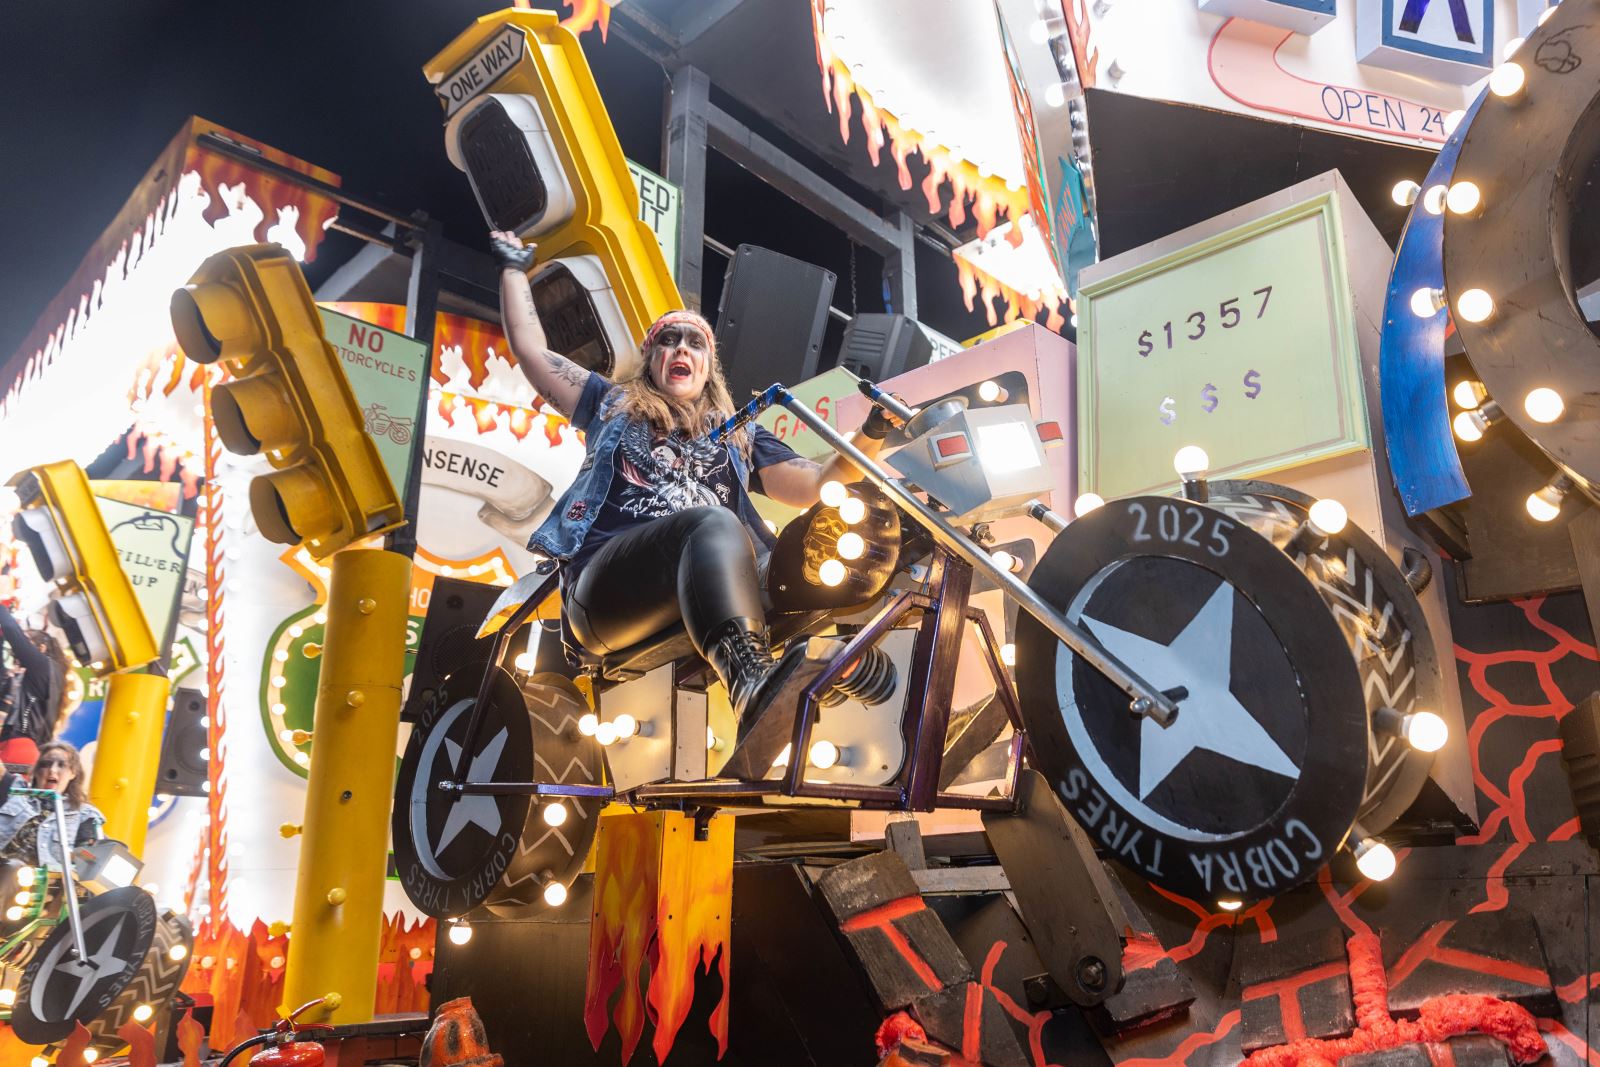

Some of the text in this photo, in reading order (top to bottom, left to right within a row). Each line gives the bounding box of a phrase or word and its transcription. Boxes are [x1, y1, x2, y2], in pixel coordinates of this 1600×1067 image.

[450, 34, 514, 102] ONE WAY
[1321, 86, 1445, 136] OPEN 24
[348, 323, 384, 353] NO
[1137, 285, 1272, 358] $1357
[774, 395, 831, 441] GAS
[1127, 502, 1235, 557] 2025
[131, 575, 158, 587] UP
[412, 682, 449, 746] 2025
[1059, 767, 1323, 893] COBRA TYRES
[405, 832, 516, 913] COBRA TYRES
[98, 951, 145, 1008] TYRES
